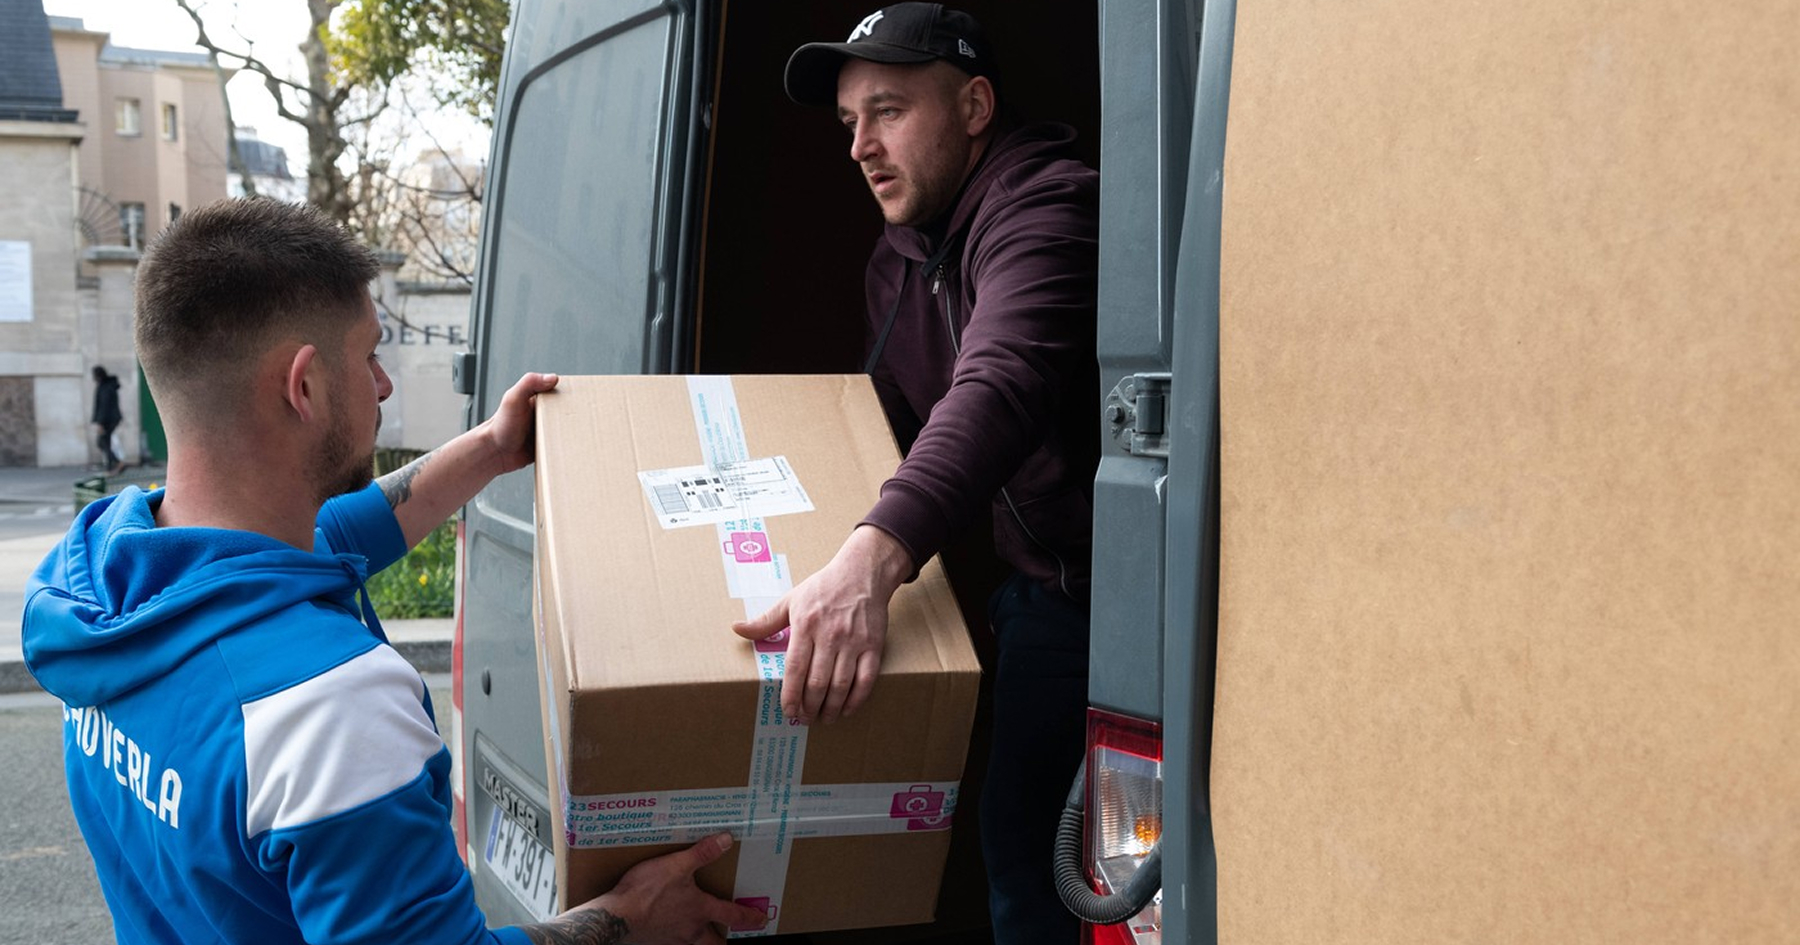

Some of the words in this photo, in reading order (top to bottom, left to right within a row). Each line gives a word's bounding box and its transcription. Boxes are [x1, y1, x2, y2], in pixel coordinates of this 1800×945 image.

[760, 653, 771, 665] de
[760, 685, 775, 727] Secours
[483, 767, 539, 837] MASTER
[597, 811, 654, 822] boutique
[601, 821, 652, 831] Secours
[577, 837, 594, 847] de
[597, 836, 619, 846] 1er
[621, 833, 671, 844] Secours
